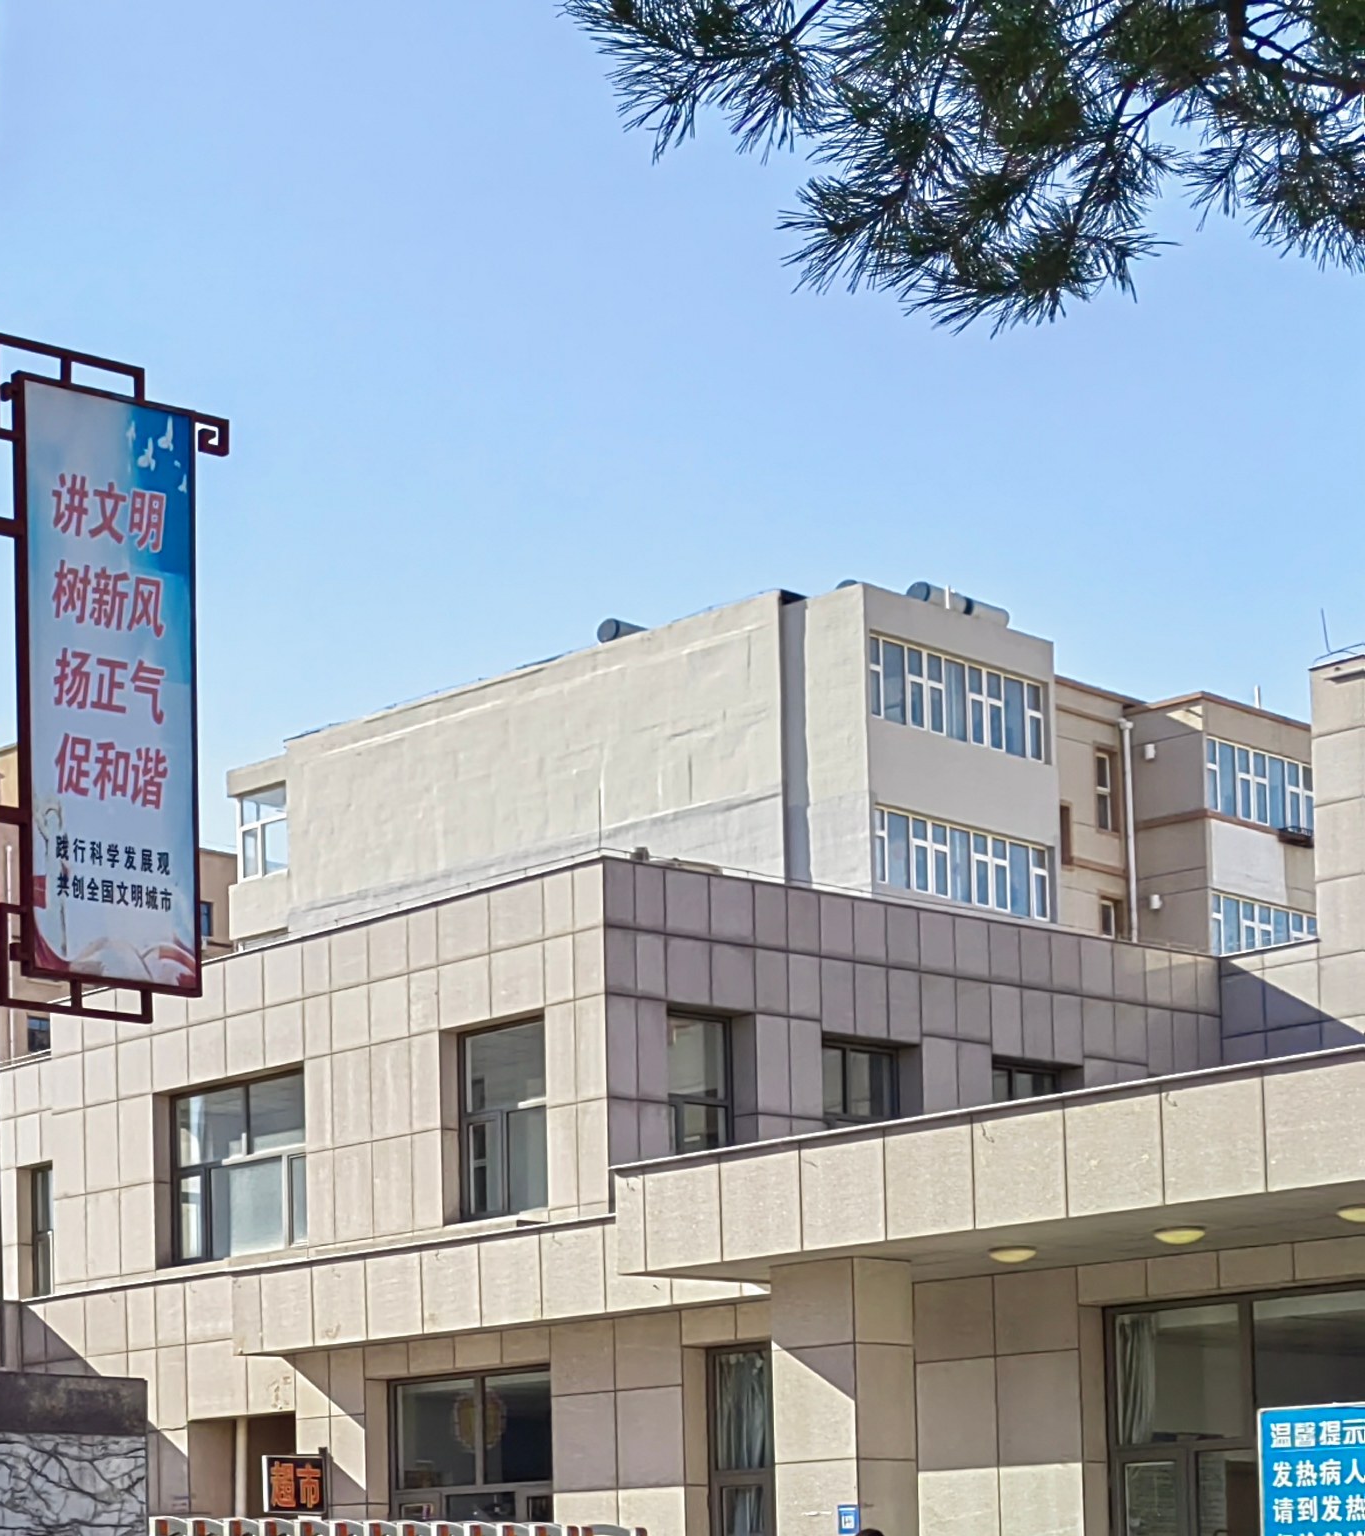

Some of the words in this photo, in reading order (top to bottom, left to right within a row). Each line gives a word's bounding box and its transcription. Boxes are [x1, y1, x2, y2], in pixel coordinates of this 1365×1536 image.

[51, 472, 166, 552] 讲文明
[51, 559, 164, 638] 树新风
[53, 647, 165, 725] 扬正气
[55, 732, 168, 810] 促和谐
[55, 832, 171, 876] 践行科学发展观
[57, 872, 173, 913] 共创全国文明城市
[270, 1460, 322, 1509] 超市
[1272, 1458, 1365, 1488] 发热病人
[1272, 1494, 1365, 1524] 请到发热
